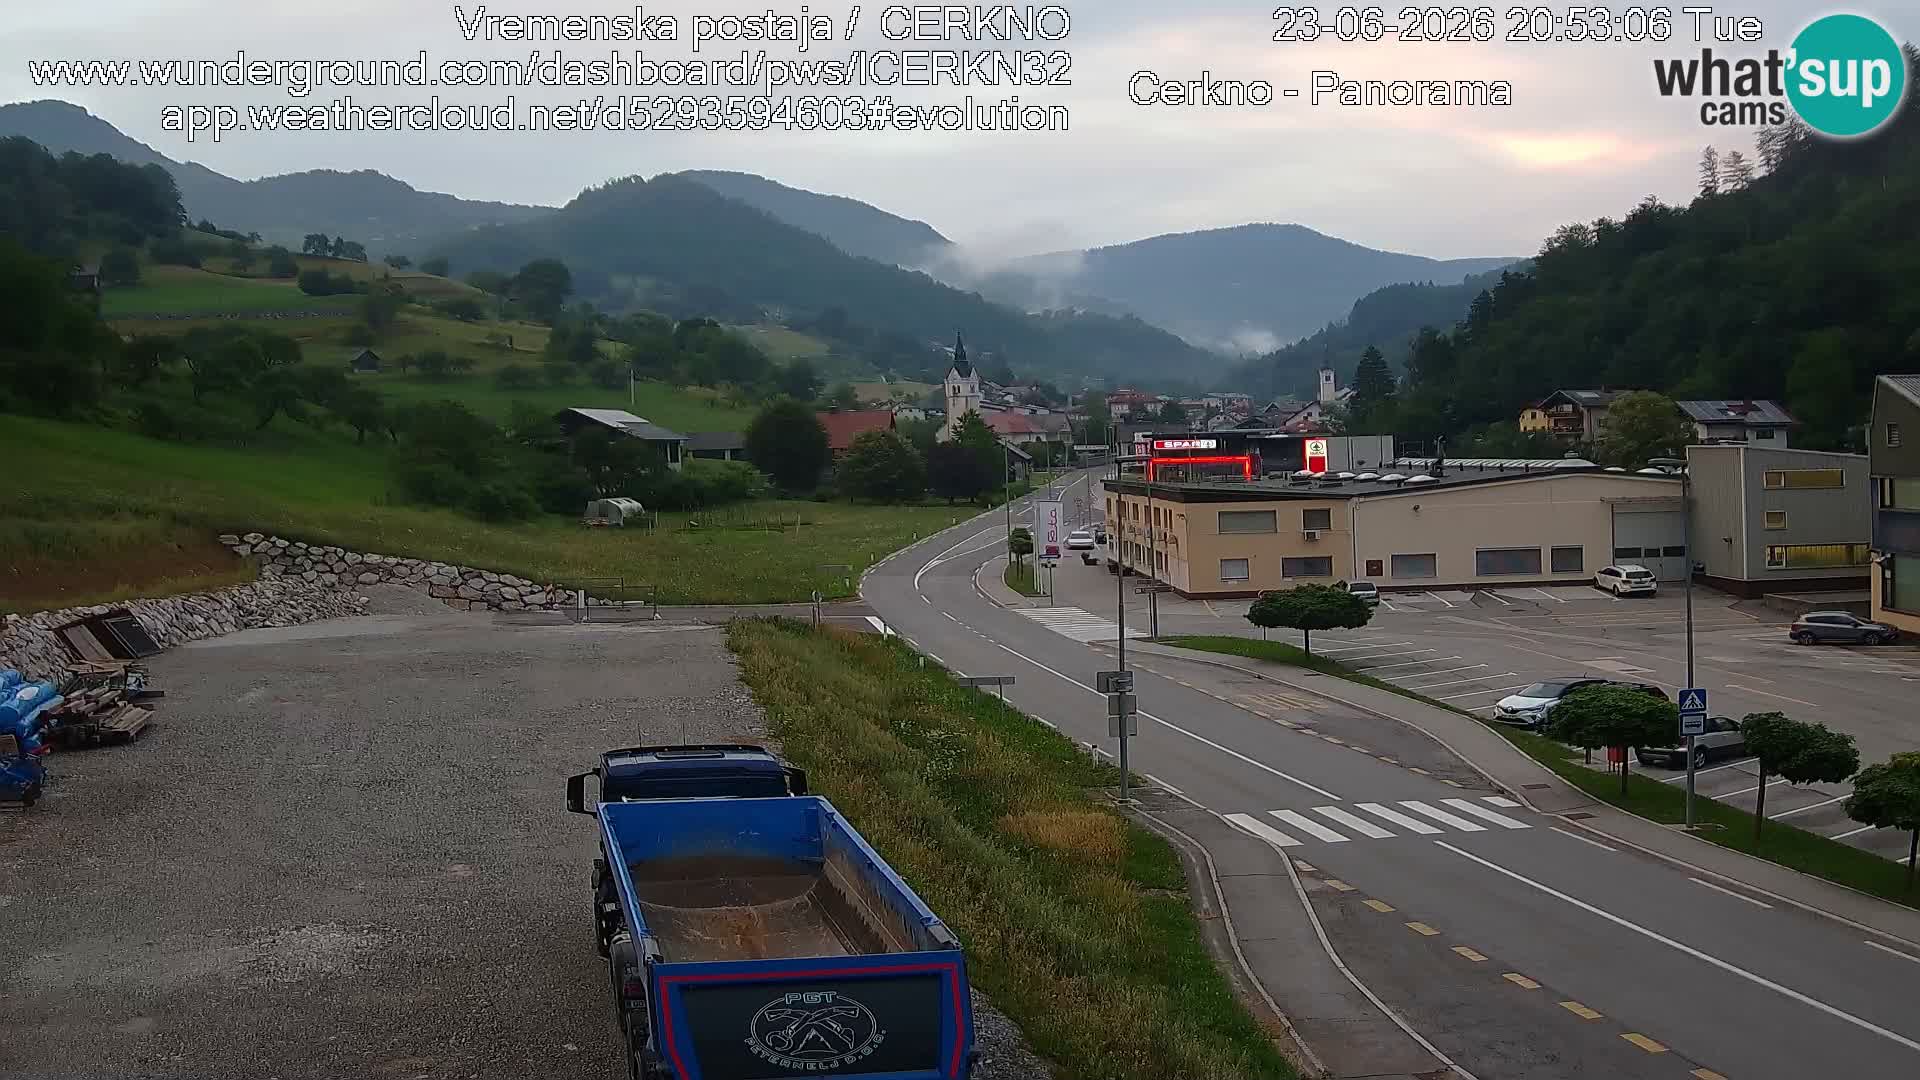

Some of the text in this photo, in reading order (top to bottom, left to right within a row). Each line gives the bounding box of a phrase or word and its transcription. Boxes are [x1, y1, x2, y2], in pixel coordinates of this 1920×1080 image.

[1164, 441, 1201, 449] SPAR
[785, 991, 837, 1004] PGT
[744, 1037, 840, 1070] PETERNELJ
